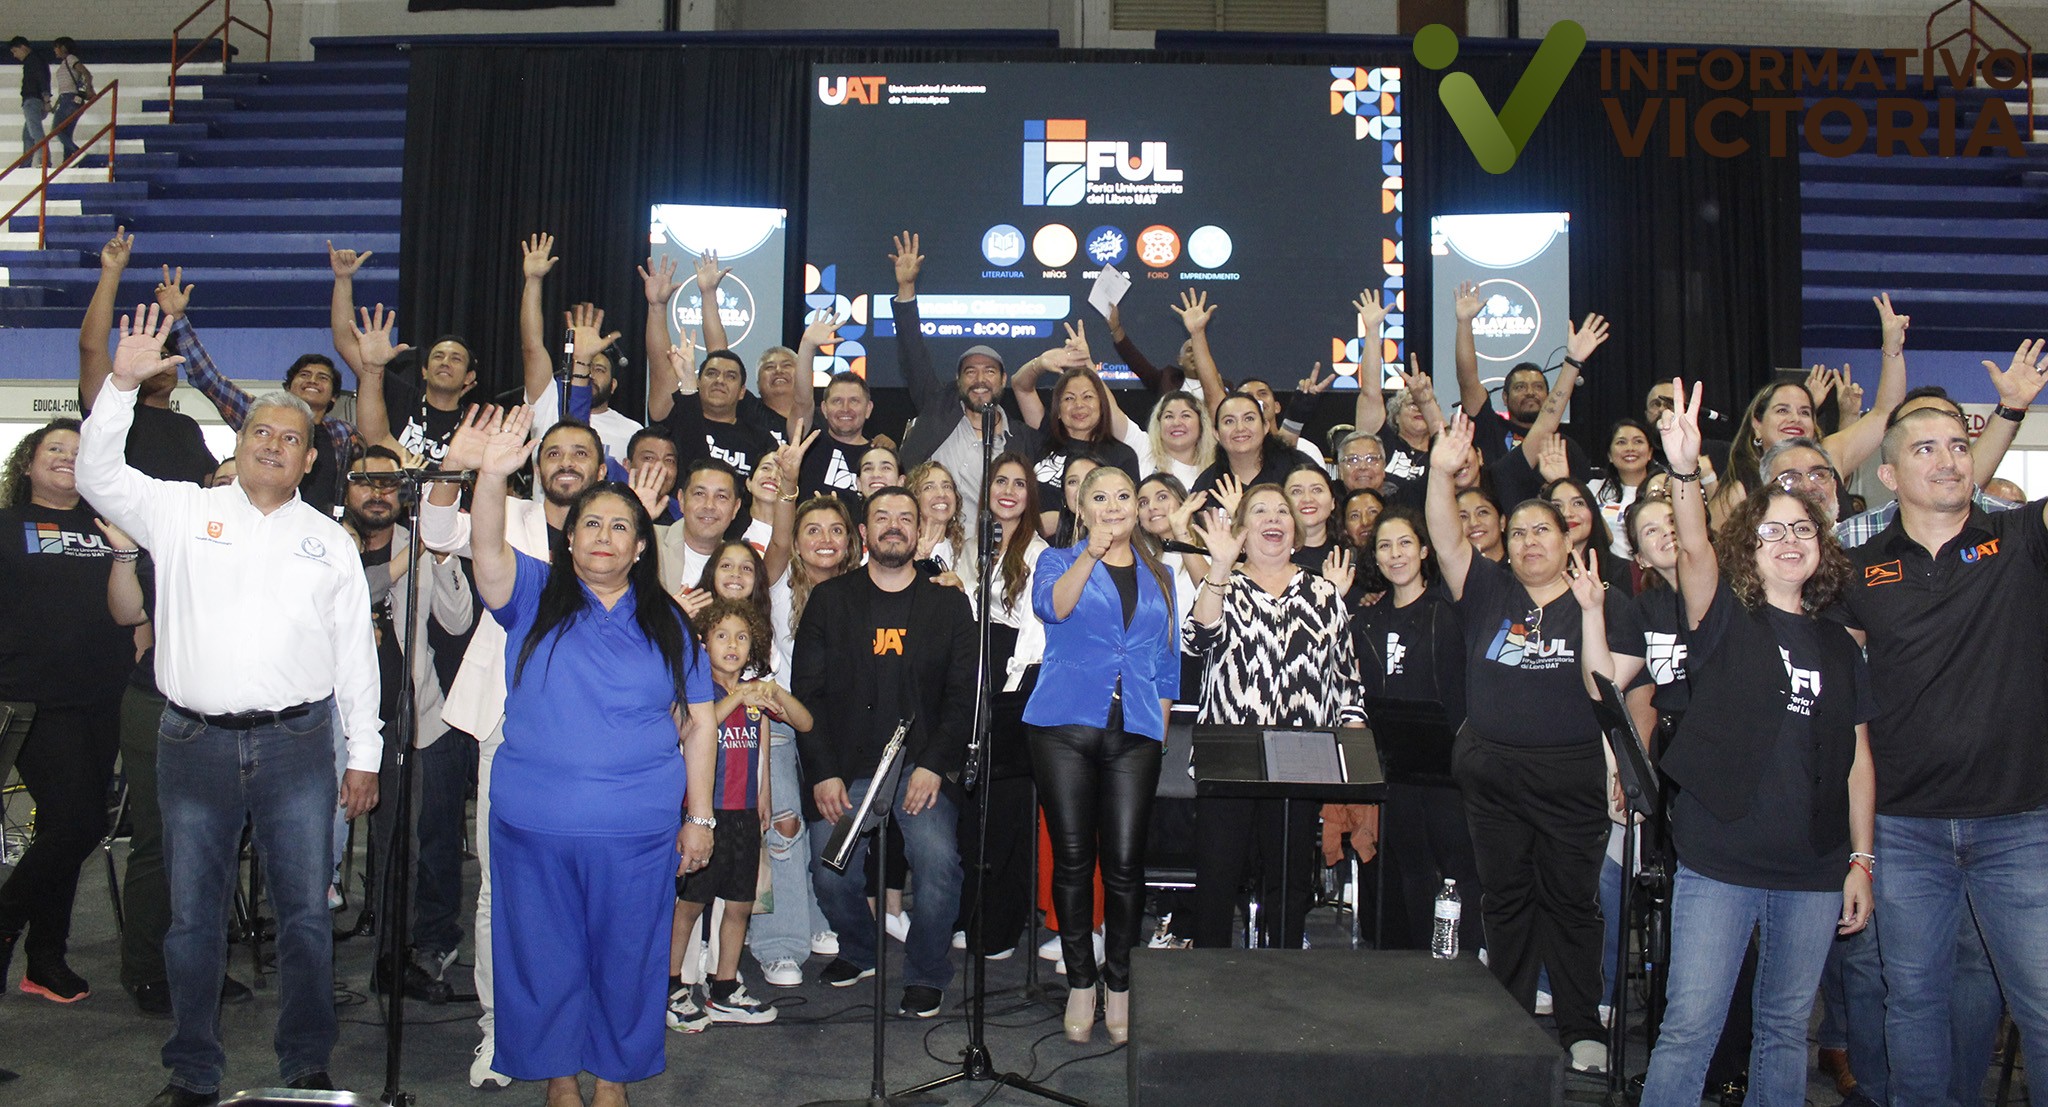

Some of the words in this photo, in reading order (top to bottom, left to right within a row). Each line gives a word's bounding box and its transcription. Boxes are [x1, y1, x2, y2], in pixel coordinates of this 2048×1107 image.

[818, 76, 887, 106] UAT
[888, 84, 940, 94] Universidad
[940, 84, 986, 94] Autónoma
[888, 96, 901, 104] de
[902, 95, 950, 106] Tamaulipas
[1087, 141, 1184, 182] FUL
[1086, 182, 1114, 193] Feria
[1115, 182, 1183, 194] Universitaria
[1086, 194, 1105, 204] del
[1105, 194, 1134, 205] Libro
[1134, 194, 1158, 205] UAT
[982, 270, 1024, 279] LITERATURA
[1042, 269, 1067, 279] NIÑOS
[1147, 271, 1169, 279] FORO
[1180, 272, 1240, 280] EMPRENDIMIENTO
[970, 298, 1047, 318] Olímpico
[938, 322, 963, 335] am
[973, 321, 1010, 335] 8:00
[1010, 324, 1036, 339] pm
[61, 530, 113, 551] FUL
[1960, 538, 2000, 564] UAT
[1523, 638, 1574, 657] FUL
[1786, 703, 1801, 713] del
[722, 741, 758, 749] AIRWAYS
